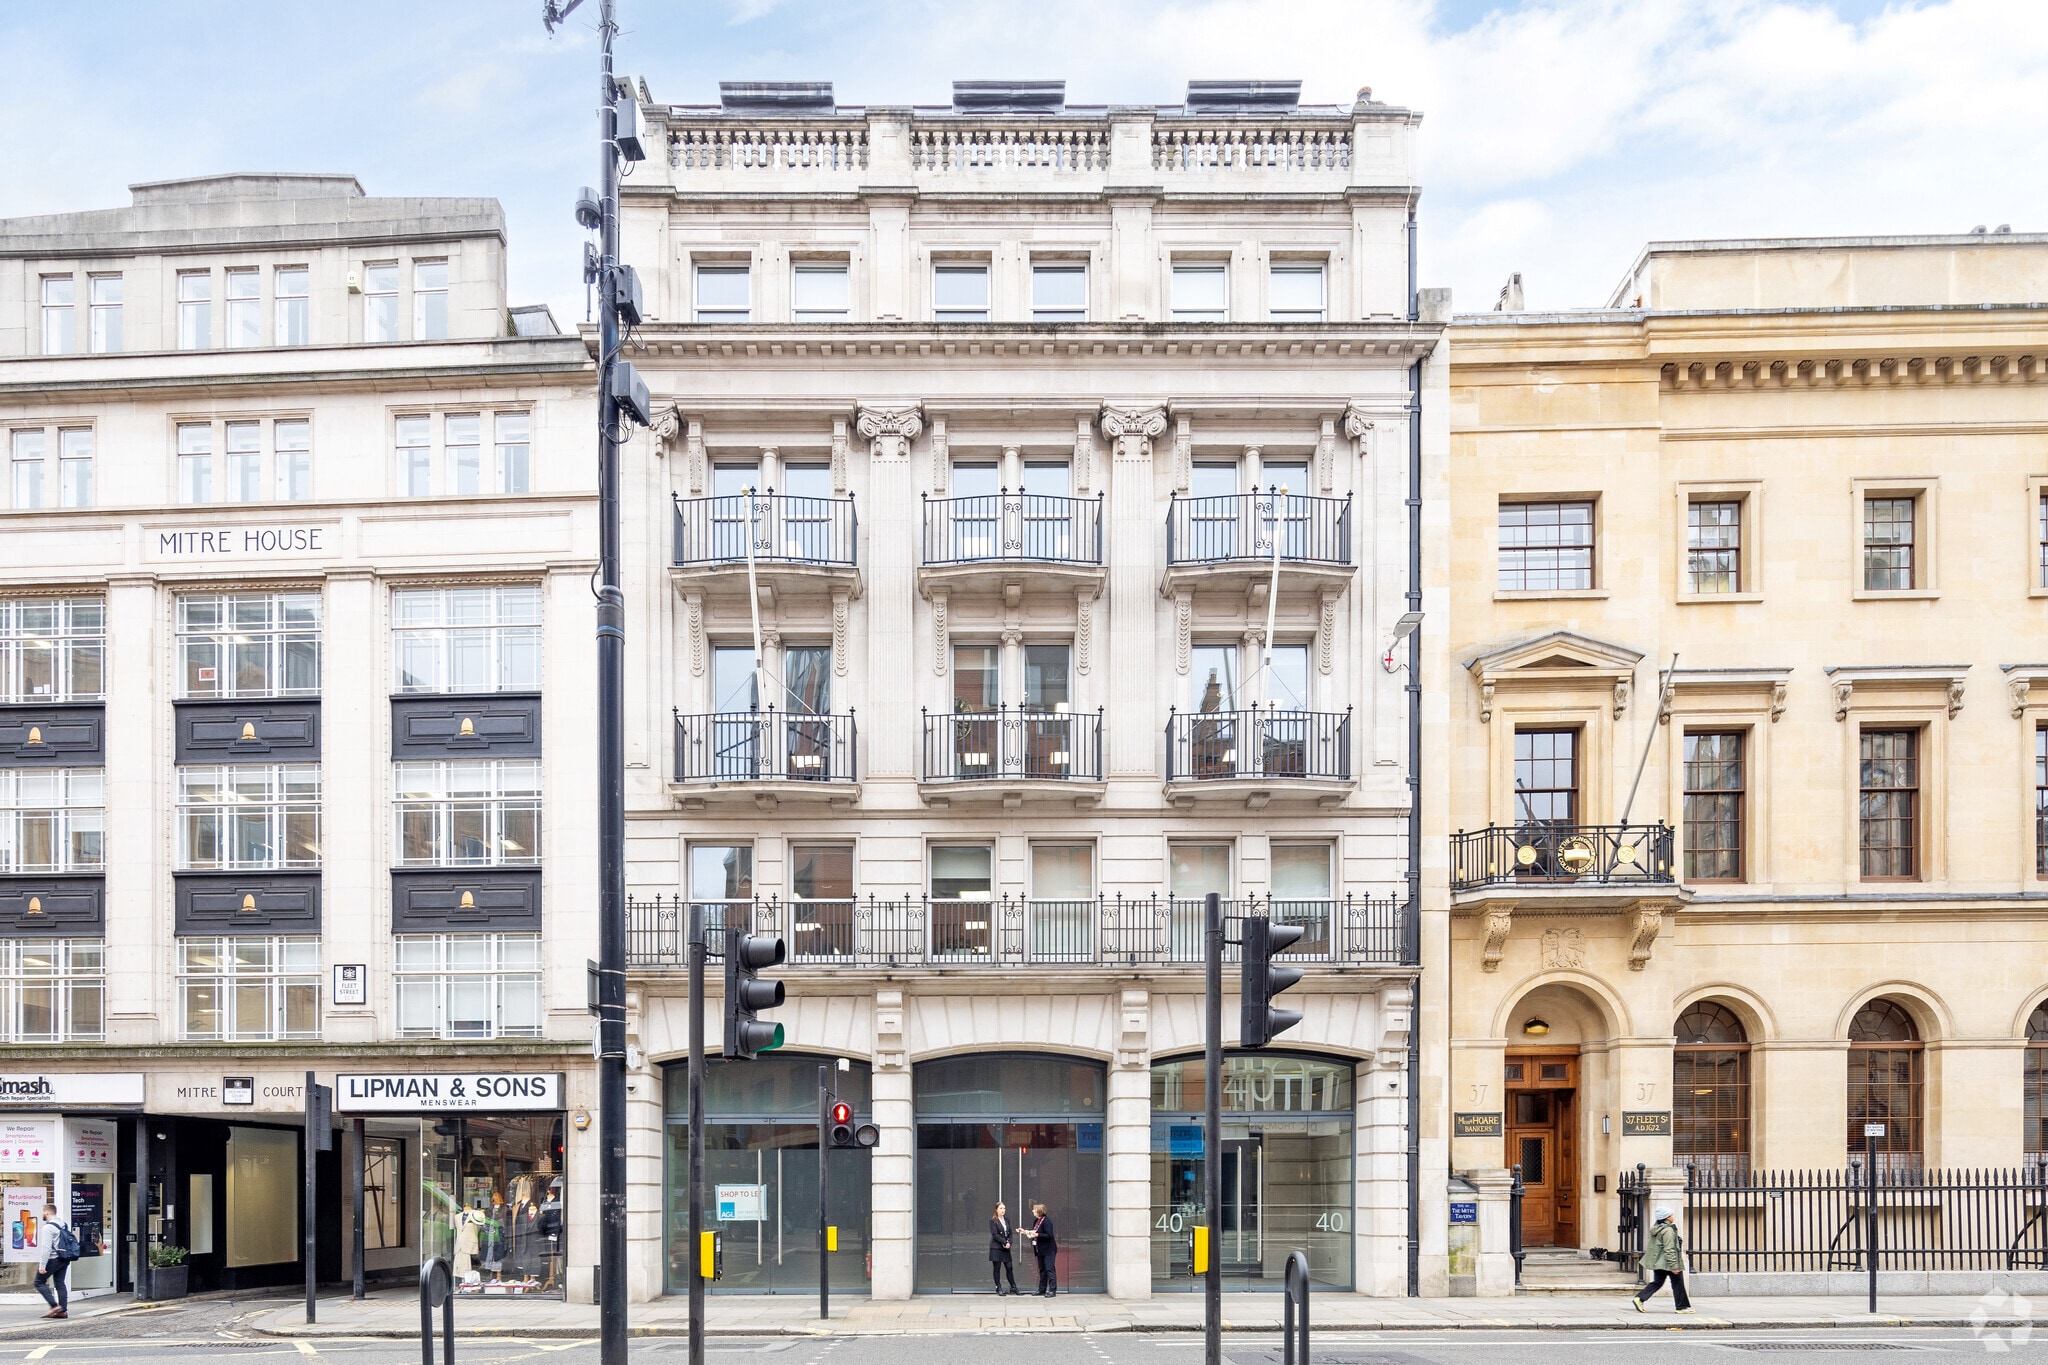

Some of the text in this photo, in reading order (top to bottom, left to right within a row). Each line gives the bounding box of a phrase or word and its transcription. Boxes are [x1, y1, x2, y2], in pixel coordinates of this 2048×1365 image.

[160, 529, 322, 554] MITRE HOUSE
[177, 1086, 303, 1098] MITRE COURT
[350, 1076, 546, 1098] LIPMAN & SONS
[1223, 1066, 1274, 1102] 40
[1637, 1083, 1656, 1105] 37
[1469, 1084, 1488, 1106] 37
[1472, 1116, 1499, 1125] HOARE
[1636, 1115, 1660, 1124] FLEET
[1155, 1213, 1183, 1232] 40
[1316, 1212, 1343, 1231] 40
